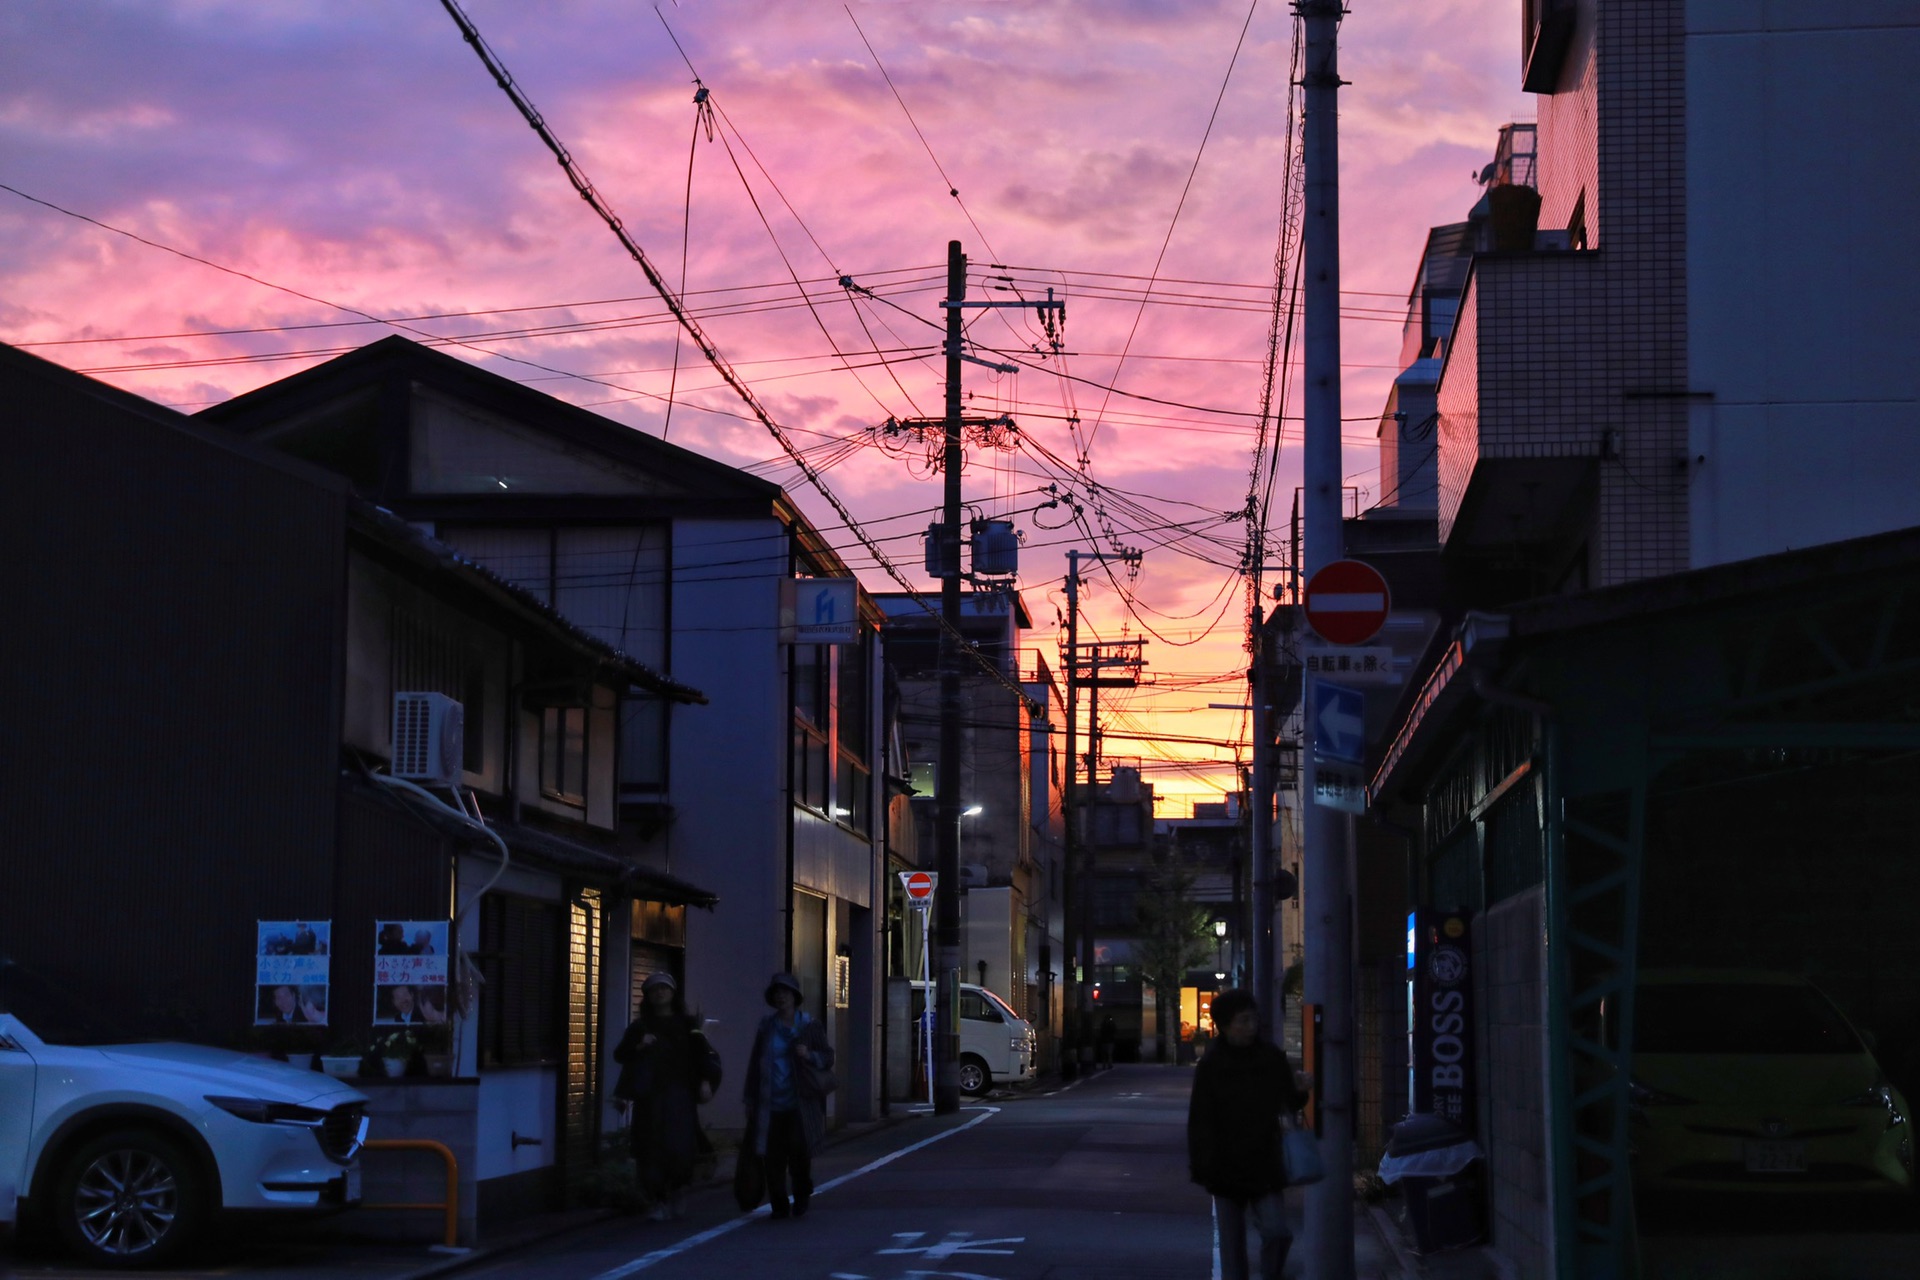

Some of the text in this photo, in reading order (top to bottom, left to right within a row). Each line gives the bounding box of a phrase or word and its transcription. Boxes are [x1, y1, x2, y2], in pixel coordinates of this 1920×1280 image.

[1306, 655, 1388, 673] 自転車を除く
[1431, 990, 1464, 1089] BOSS
